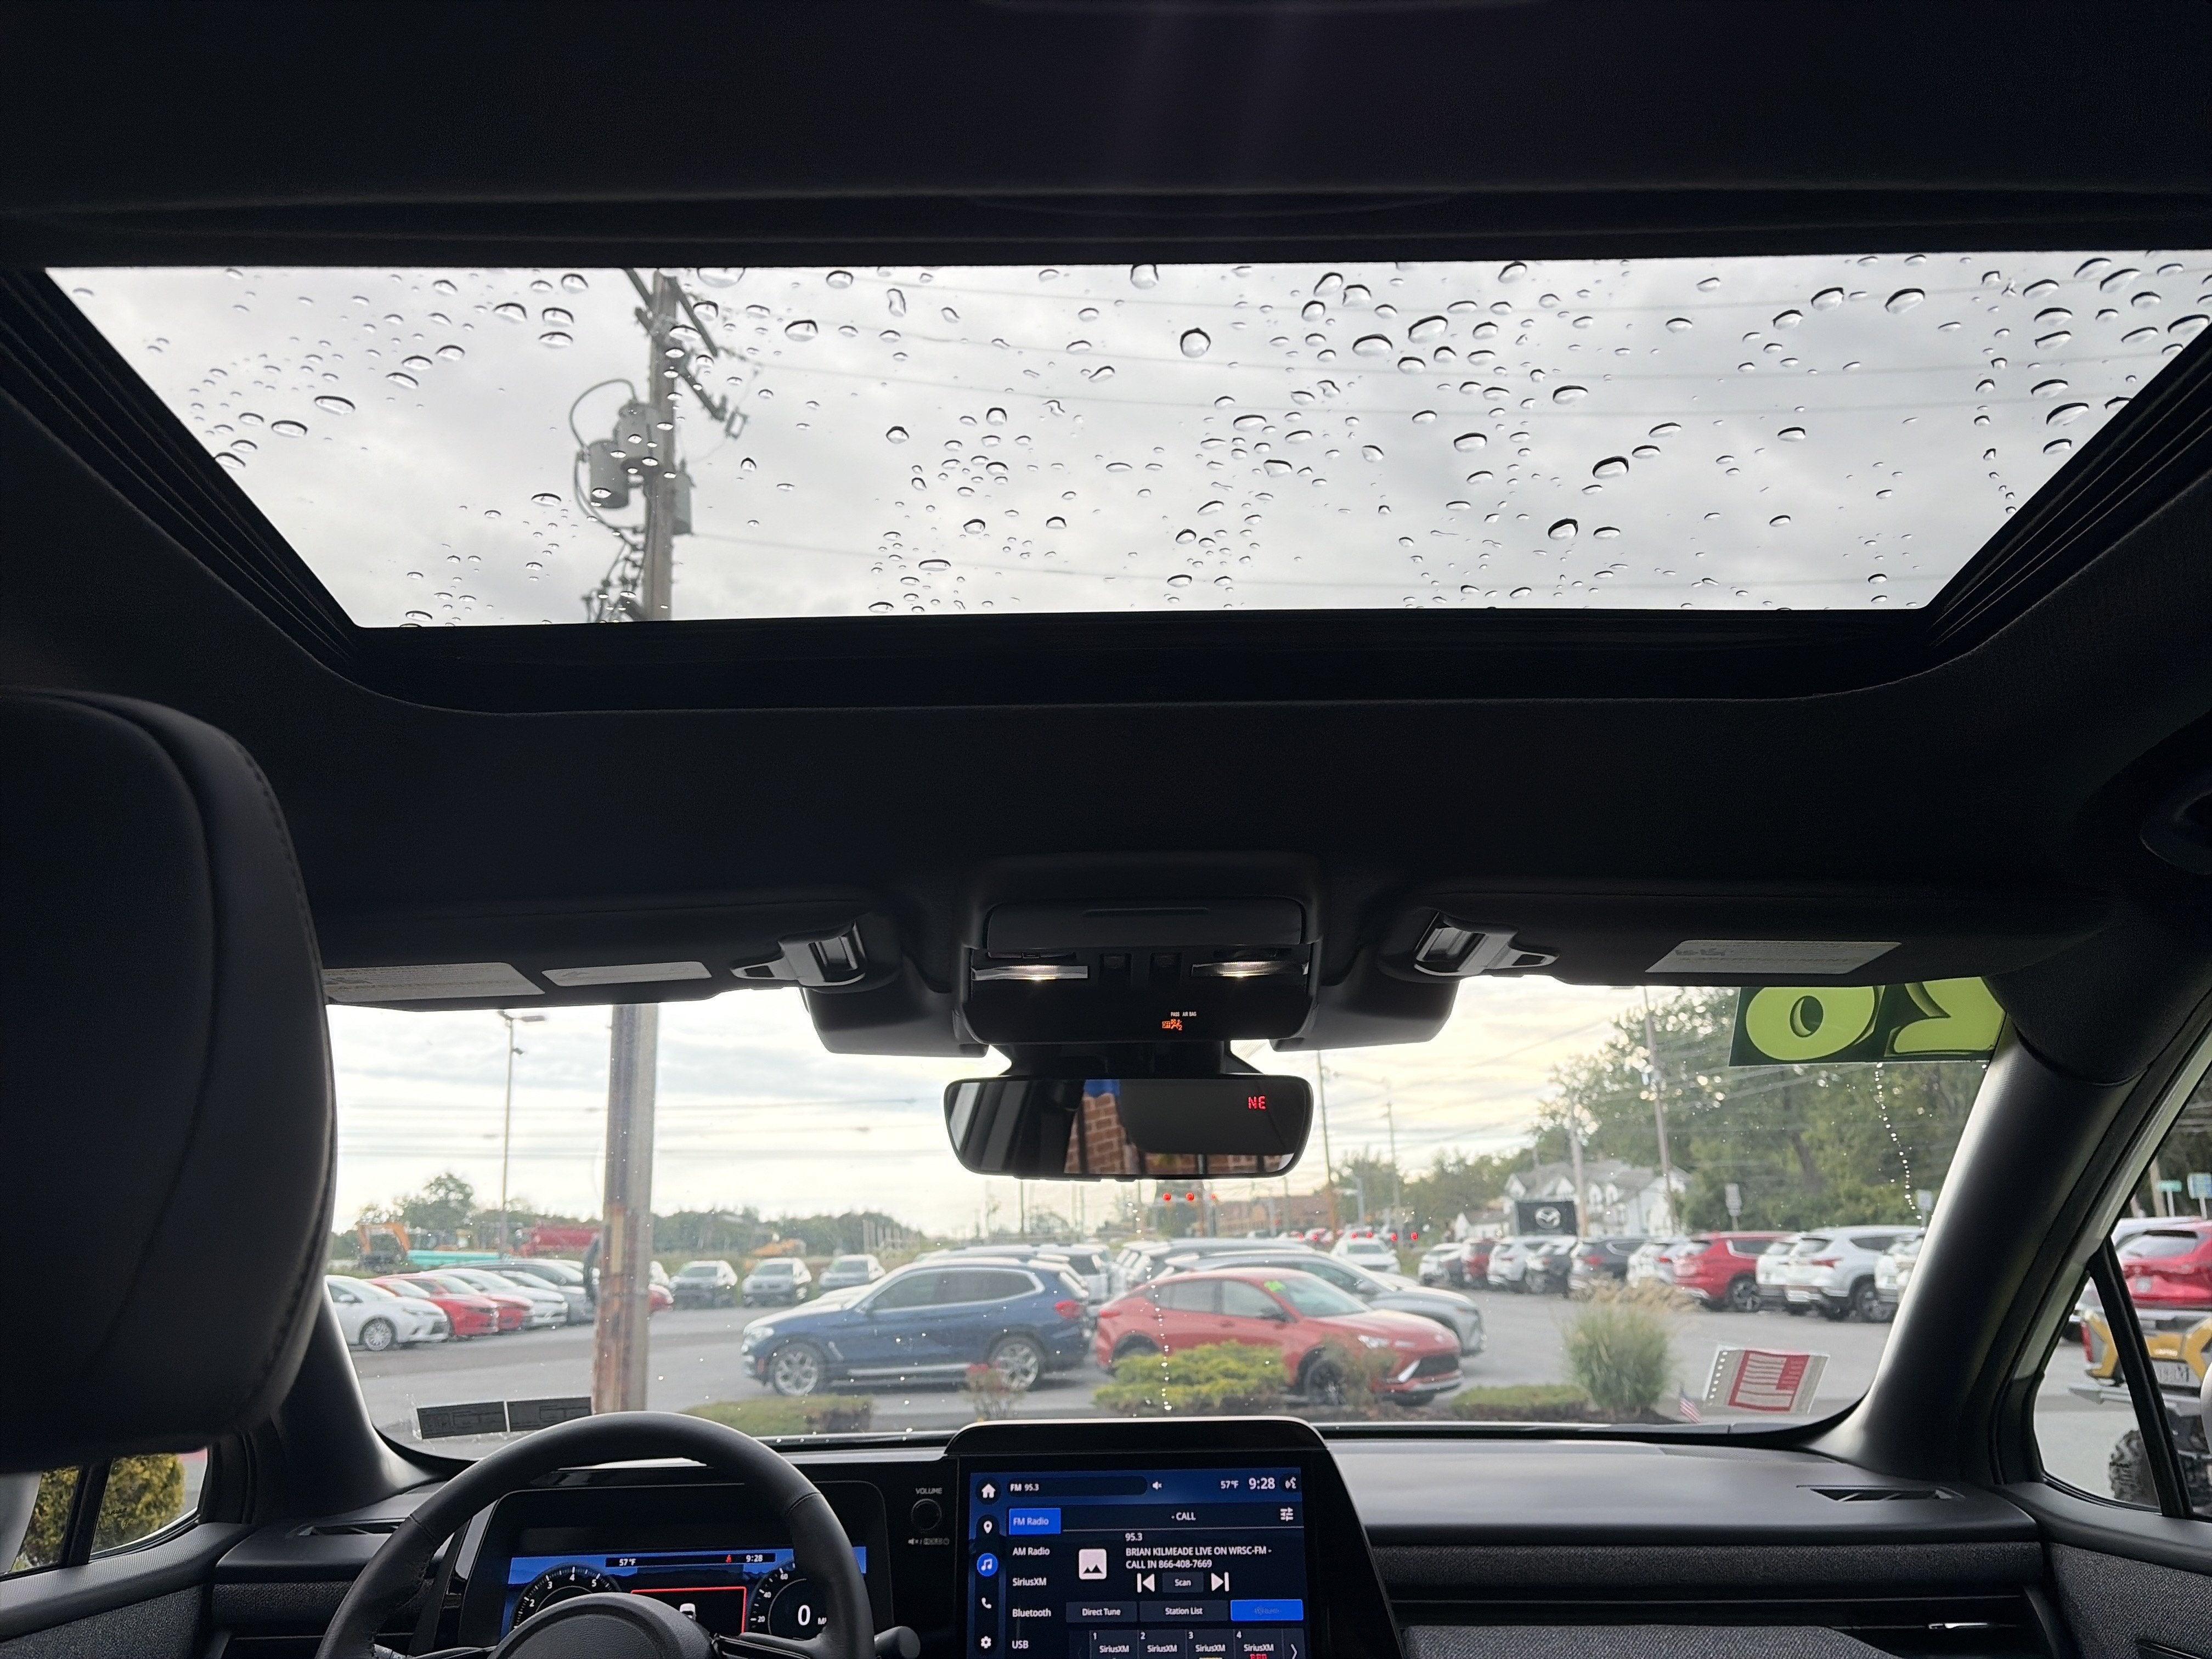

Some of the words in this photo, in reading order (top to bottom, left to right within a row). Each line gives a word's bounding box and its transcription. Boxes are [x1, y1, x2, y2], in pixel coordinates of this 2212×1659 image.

[1248, 1096, 1266, 1110] NE
[1249, 1477, 1276, 1489] 9:28
[1176, 1512, 1196, 1521] CALL
[1013, 1517, 1025, 1526] FM
[1027, 1517, 1049, 1525] Radio
[1125, 1532, 1143, 1541] 95.3
[1012, 1547, 1026, 1556] AM
[1028, 1547, 1050, 1555] Radio
[1126, 1548, 1151, 1556] BRIAN
[1153, 1547, 1193, 1556] KILMEADE
[1195, 1547, 1212, 1555] LIVE
[1214, 1546, 1227, 1555] ON
[1228, 1545, 1266, 1555] WRSC-FM
[619, 1558, 636, 1566] 57°F
[746, 1554, 763, 1562] 9:28
[1126, 1560, 1146, 1569] CALL
[1147, 1560, 1157, 1568] IN
[1159, 1559, 1212, 1568] 866-408-7669
[591, 1579, 597, 1587] 5
[1012, 1577, 1047, 1587] SiriusXM
[529, 1599, 535, 1607] 2
[1012, 1608, 1051, 1617] Bluetooth
[1082, 1608, 1102, 1616] Direct
[1165, 1607, 1189, 1615] Station
[1190, 1606, 1203, 1615] List
[797, 1605, 811, 1626] 0
[1012, 1640, 1029, 1649] USB
[1099, 1645, 1129, 1653] SiriusXM
[1147, 1644, 1177, 1652] SiriusXM
[1195, 1644, 1226, 1652] SiriusXM
[1243, 1644, 1274, 1652] SiriusXM
